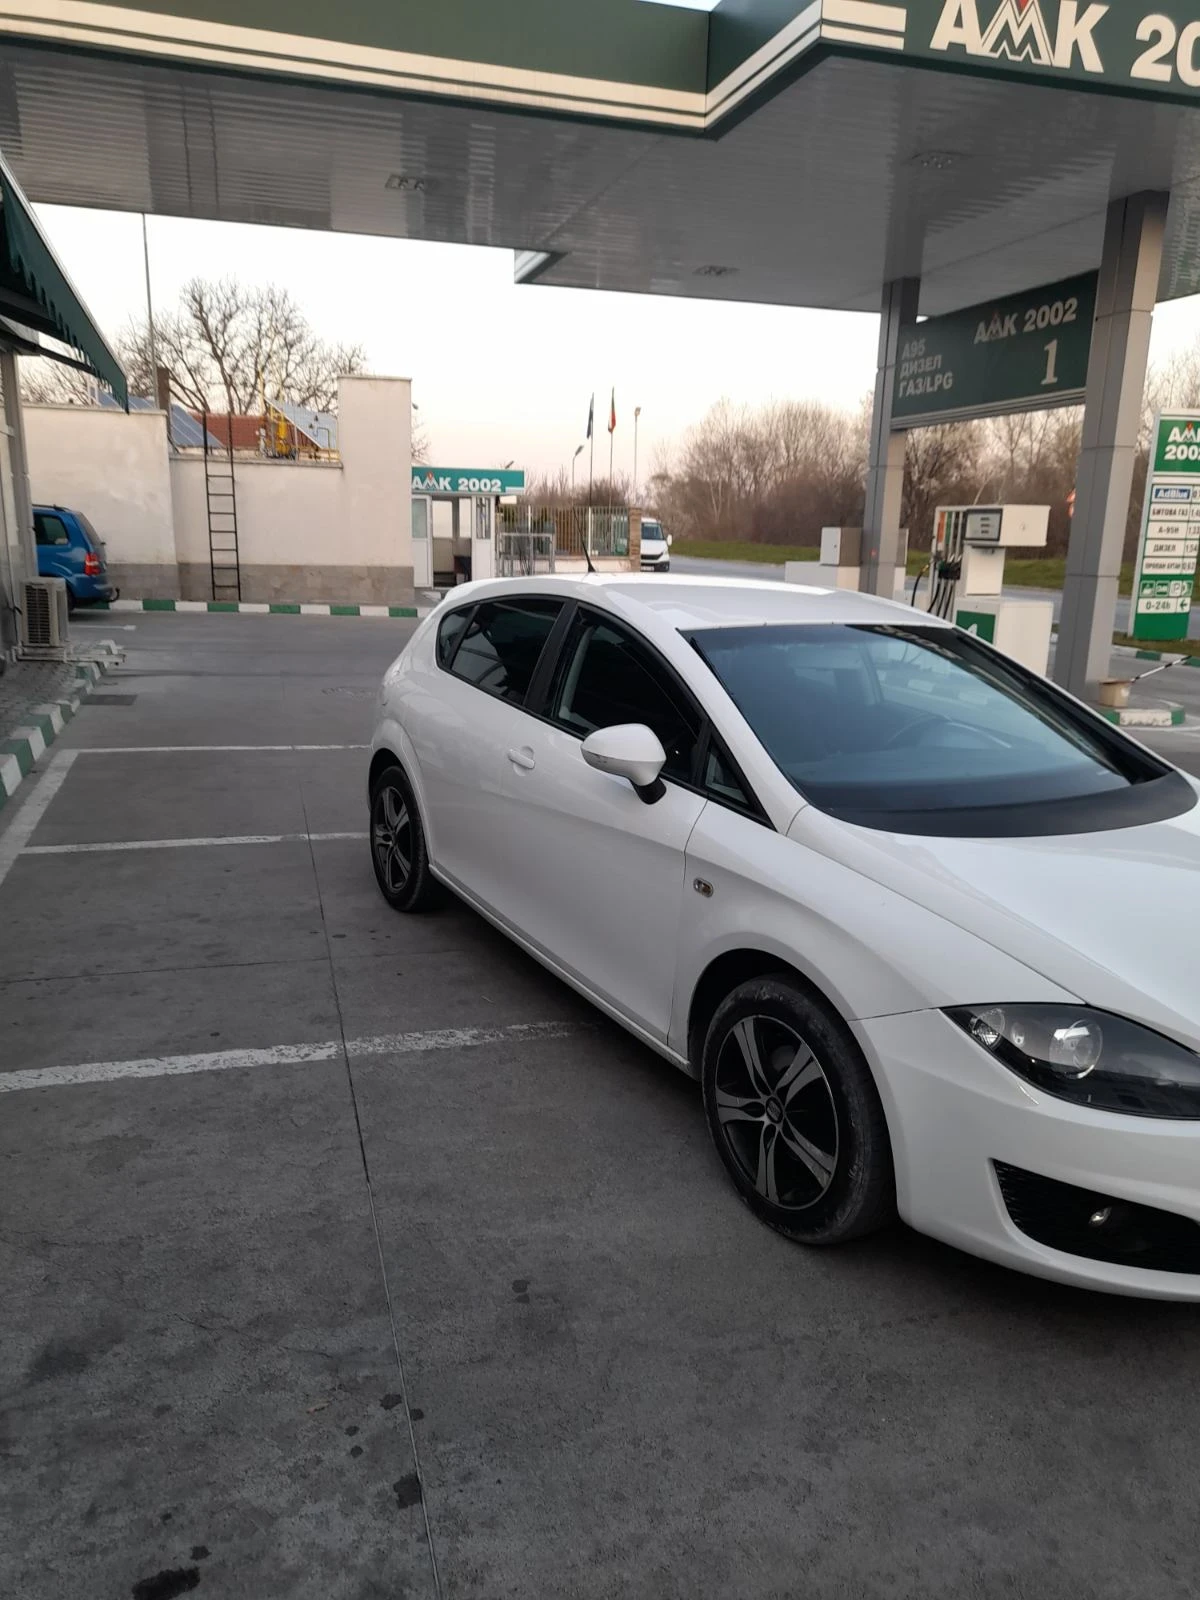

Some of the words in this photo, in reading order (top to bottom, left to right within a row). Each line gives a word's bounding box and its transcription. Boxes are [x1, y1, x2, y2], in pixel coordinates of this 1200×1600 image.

[1023, 297, 1078, 333] 2002
[899, 355, 942, 379] ДИЗЕЛ
[1040, 339, 1058, 385] 1
[899, 372, 954, 398] ГАЗ/LPG
[1164, 445, 1200, 460] 200
[458, 478, 501, 492] 2002
